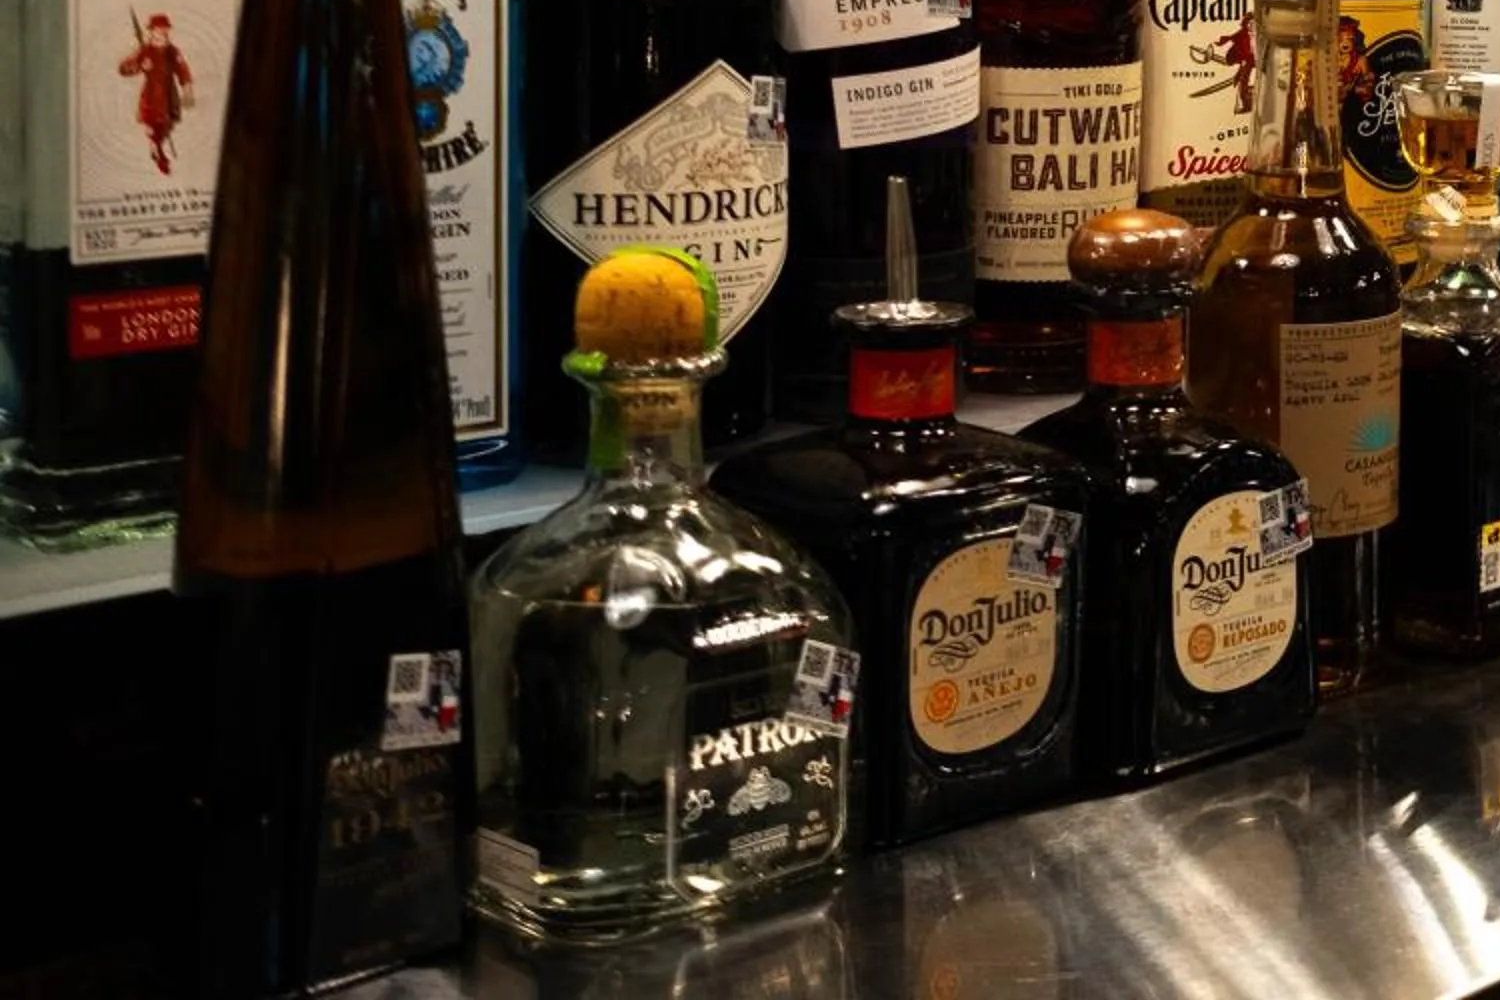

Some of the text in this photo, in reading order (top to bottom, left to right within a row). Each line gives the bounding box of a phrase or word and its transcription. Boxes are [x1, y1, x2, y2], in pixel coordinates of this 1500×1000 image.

[840, 10, 893, 33] 1908
[847, 77, 934, 102] INDIGO GIN
[1063, 83, 1124, 99] TIKI GOLD
[987, 102, 1141, 145] CUTWATE
[1010, 147, 1137, 191] BALI HA
[984, 210, 1060, 225] PINEAPPLE
[987, 227, 1056, 240] FLAVORED
[1223, 619, 1287, 648] REPOSADO
[967, 668, 1016, 687] TEQUILA
